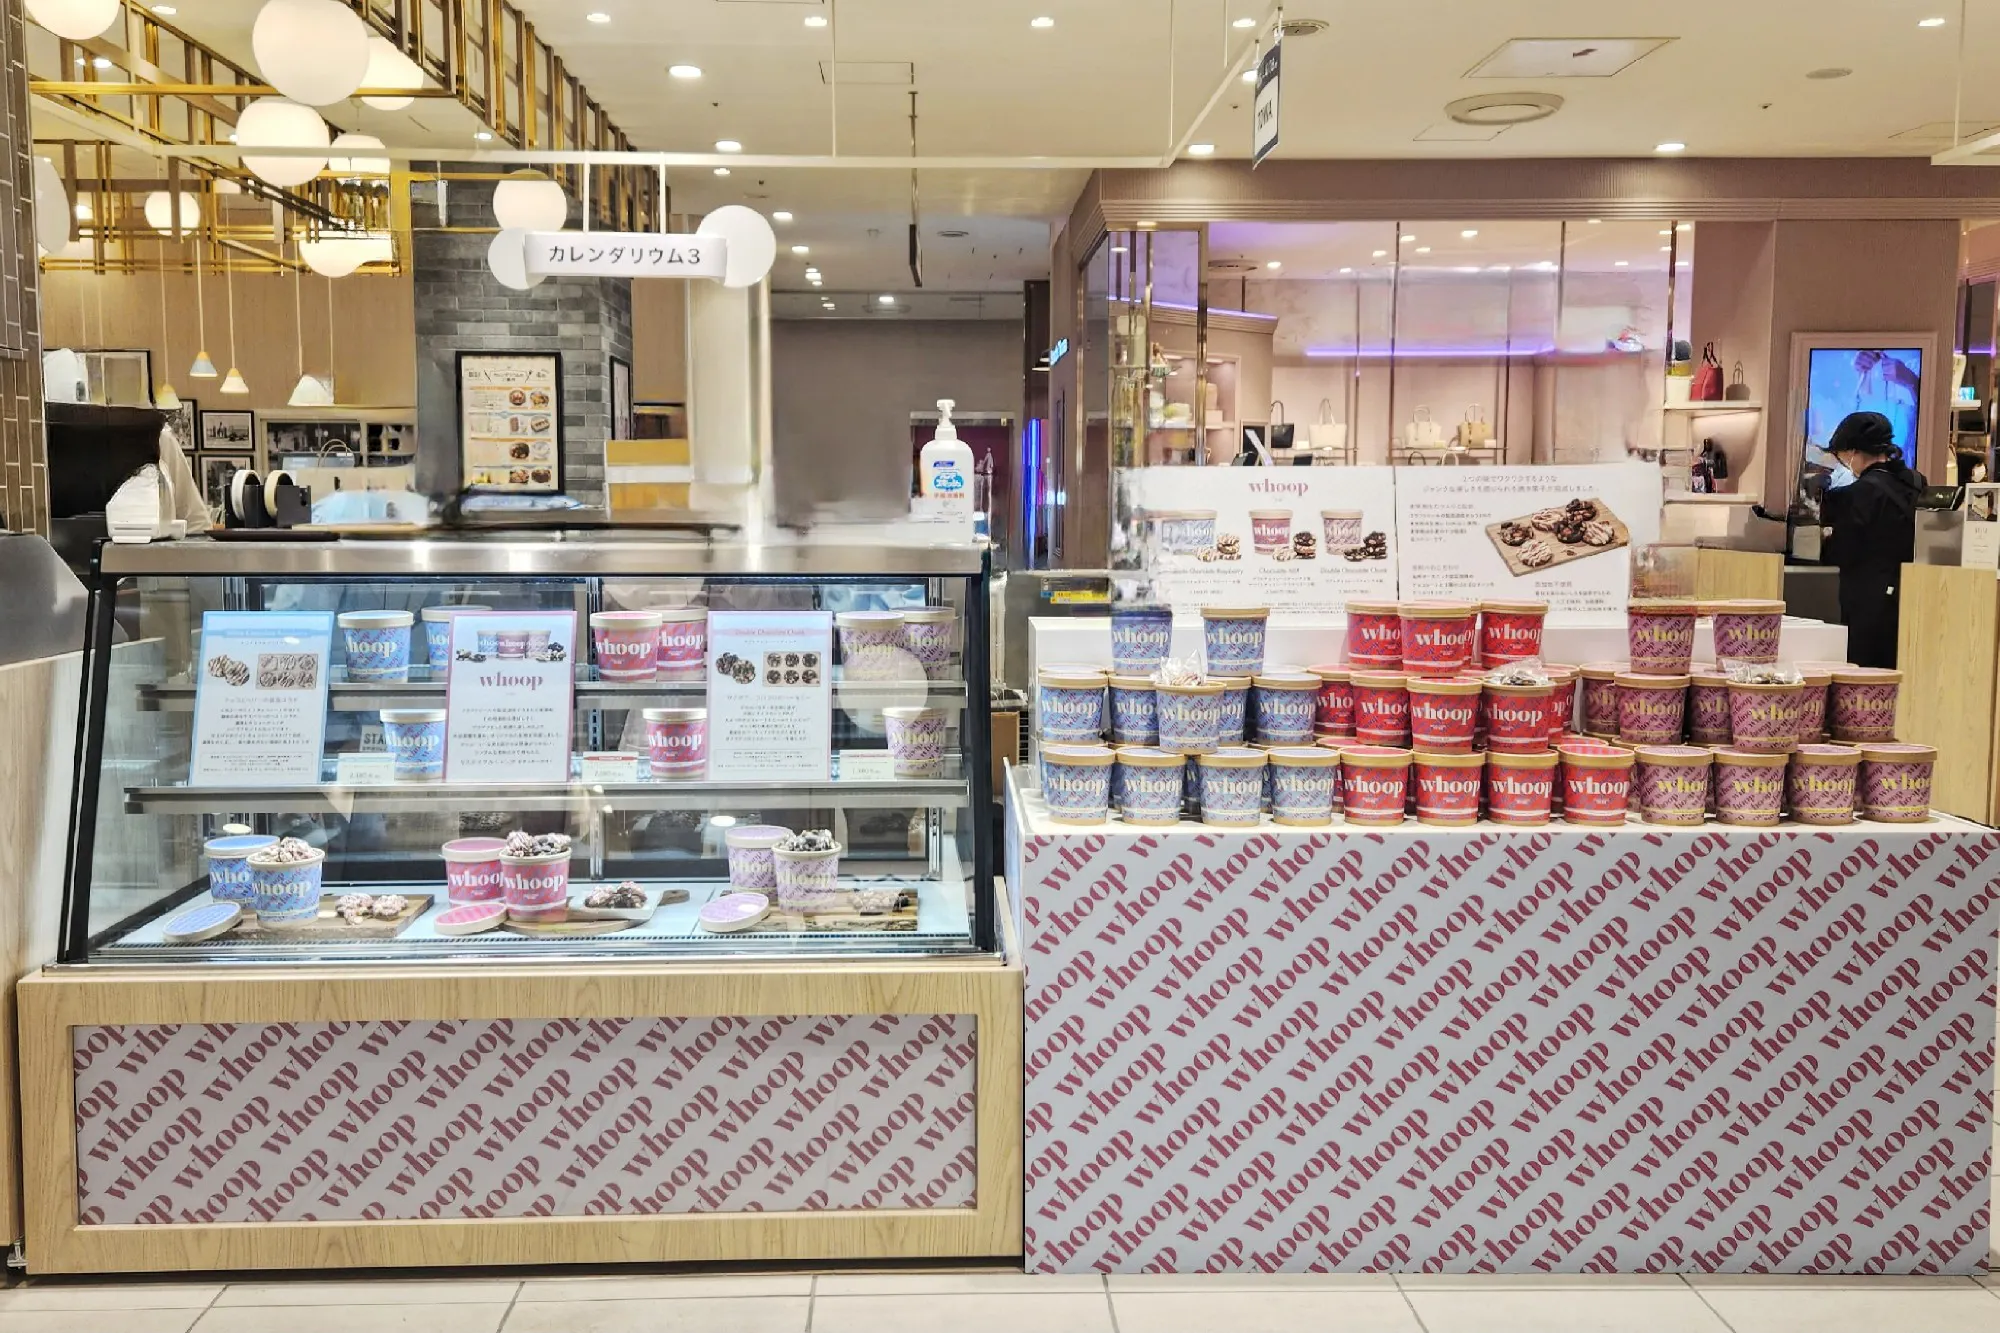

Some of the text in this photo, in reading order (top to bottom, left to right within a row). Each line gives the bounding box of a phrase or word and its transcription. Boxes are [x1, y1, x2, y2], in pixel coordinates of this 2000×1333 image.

[549, 245, 700, 264] カレンダリウム3
[1249, 478, 1309, 497] whoop
[480, 671, 544, 691] whoop
[596, 638, 651, 659] whoop
[657, 631, 704, 650] hoop
[1113, 628, 1168, 647] whoop
[1206, 628, 1262, 647] whoop
[363, 733, 387, 745] STA
[648, 730, 702, 751] whoop
[1042, 696, 1097, 717] whoop
[1162, 703, 1220, 725] whoop
[1259, 698, 1316, 719] whoop
[1413, 702, 1472, 725] whoop
[1048, 773, 1106, 797] whoop
[1124, 774, 1182, 796] whoop
[1275, 775, 1334, 796] whoop
[1345, 775, 1403, 798] whoop
[1420, 775, 1480, 797] whoop
[1492, 775, 1552, 798] whoop
[1793, 774, 1856, 795] whoop
[252, 880, 312, 898] whoop
[504, 873, 564, 892] whoop
[1032, 864, 1126, 954] whoop
[1099, 853, 1193, 943] whoop
[1267, 850, 1362, 940] whoop
[1334, 841, 1430, 930] whoop
[1477, 863, 1573, 952] whoop
[1544, 852, 1639, 942] whoop
[1715, 849, 1811, 939] whoop
[1782, 839, 1878, 929] whoop
[1088, 918, 1181, 1007] whoop
[1154, 908, 1247, 998] whoop
[1235, 938, 1329, 1027] whoop
[1322, 904, 1418, 994] whoop
[1389, 896, 1483, 985] whoop
[1532, 918, 1628, 1007] whoop
[1599, 908, 1694, 997] whoop
[1681, 936, 1776, 1026] whoop
[1770, 904, 1865, 994] whoop
[1836, 896, 1932, 984] whoop
[1026, 951, 1094, 1021] hoop
[1168, 947, 1262, 1036] whoop
[1377, 959, 1471, 1048] whoop
[1444, 949, 1539, 1039] whoop
[1613, 947, 1709, 1036] whoop
[1823, 960, 1919, 1048] whoop
[1891, 949, 1987, 1039] whoop
[418, 1018, 512, 1109] whoop
[1056, 1005, 1150, 1095] whoop
[1136, 1034, 1230, 1123] whoop
[1224, 1002, 1318, 1091] whoop
[1290, 992, 1384, 1081] whoop
[1432, 1014, 1527, 1103] whoop
[1498, 1003, 1593, 1093] whoop
[1580, 1034, 1675, 1123] whoop
[1668, 1001, 1763, 1089] whoop
[1735, 992, 1829, 1081] whoop
[1878, 1013, 1973, 1101] whoop
[90, 1070, 185, 1160] whoop
[263, 1063, 358, 1153] whoop
[330, 1050, 425, 1141] whoop
[475, 1069, 570, 1160] whoop
[543, 1059, 635, 1149] whoop
[711, 1053, 804, 1142] whoop
[778, 1040, 871, 1131] whoop
[1071, 1044, 1164, 1133] whoop
[1279, 1056, 1372, 1143] whoop
[1344, 1045, 1439, 1135] whoop
[1513, 1042, 1608, 1132] whoop
[1722, 1055, 1817, 1144] whoop
[1789, 1045, 1884, 1134] whoop
[106, 1109, 202, 1201] whoop
[175, 1097, 269, 1187] whoop
[322, 1115, 416, 1206] whoop
[391, 1104, 483, 1194] whoop
[559, 1097, 651, 1186] whoop
[626, 1087, 718, 1175] whoop
[766, 1104, 859, 1194] whoop
[832, 1094, 925, 1183] whoop
[1040, 1131, 1133, 1220] whoop
[1127, 1098, 1220, 1187] whoop
[1192, 1088, 1285, 1176] whoop
[1333, 1110, 1428, 1198] whoop
[1400, 1100, 1494, 1189] whoop
[1480, 1129, 1574, 1217] whoop
[1568, 1097, 1664, 1185] whoop
[1634, 1088, 1729, 1176] whoop
[1777, 1109, 1872, 1198] whoop
[1844, 1101, 1938, 1188] whoop
[1180, 1152, 1275, 1240] whoop
[1247, 1142, 1340, 1230] whoop
[1414, 1138, 1509, 1226] whoop
[1622, 1152, 1717, 1239] whoop
[1688, 1141, 1783, 1229] whoop
[1857, 1139, 1953, 1226] whoop
[1094, 1184, 1188, 1273] whoop
[1534, 1184, 1629, 1270] whoop
